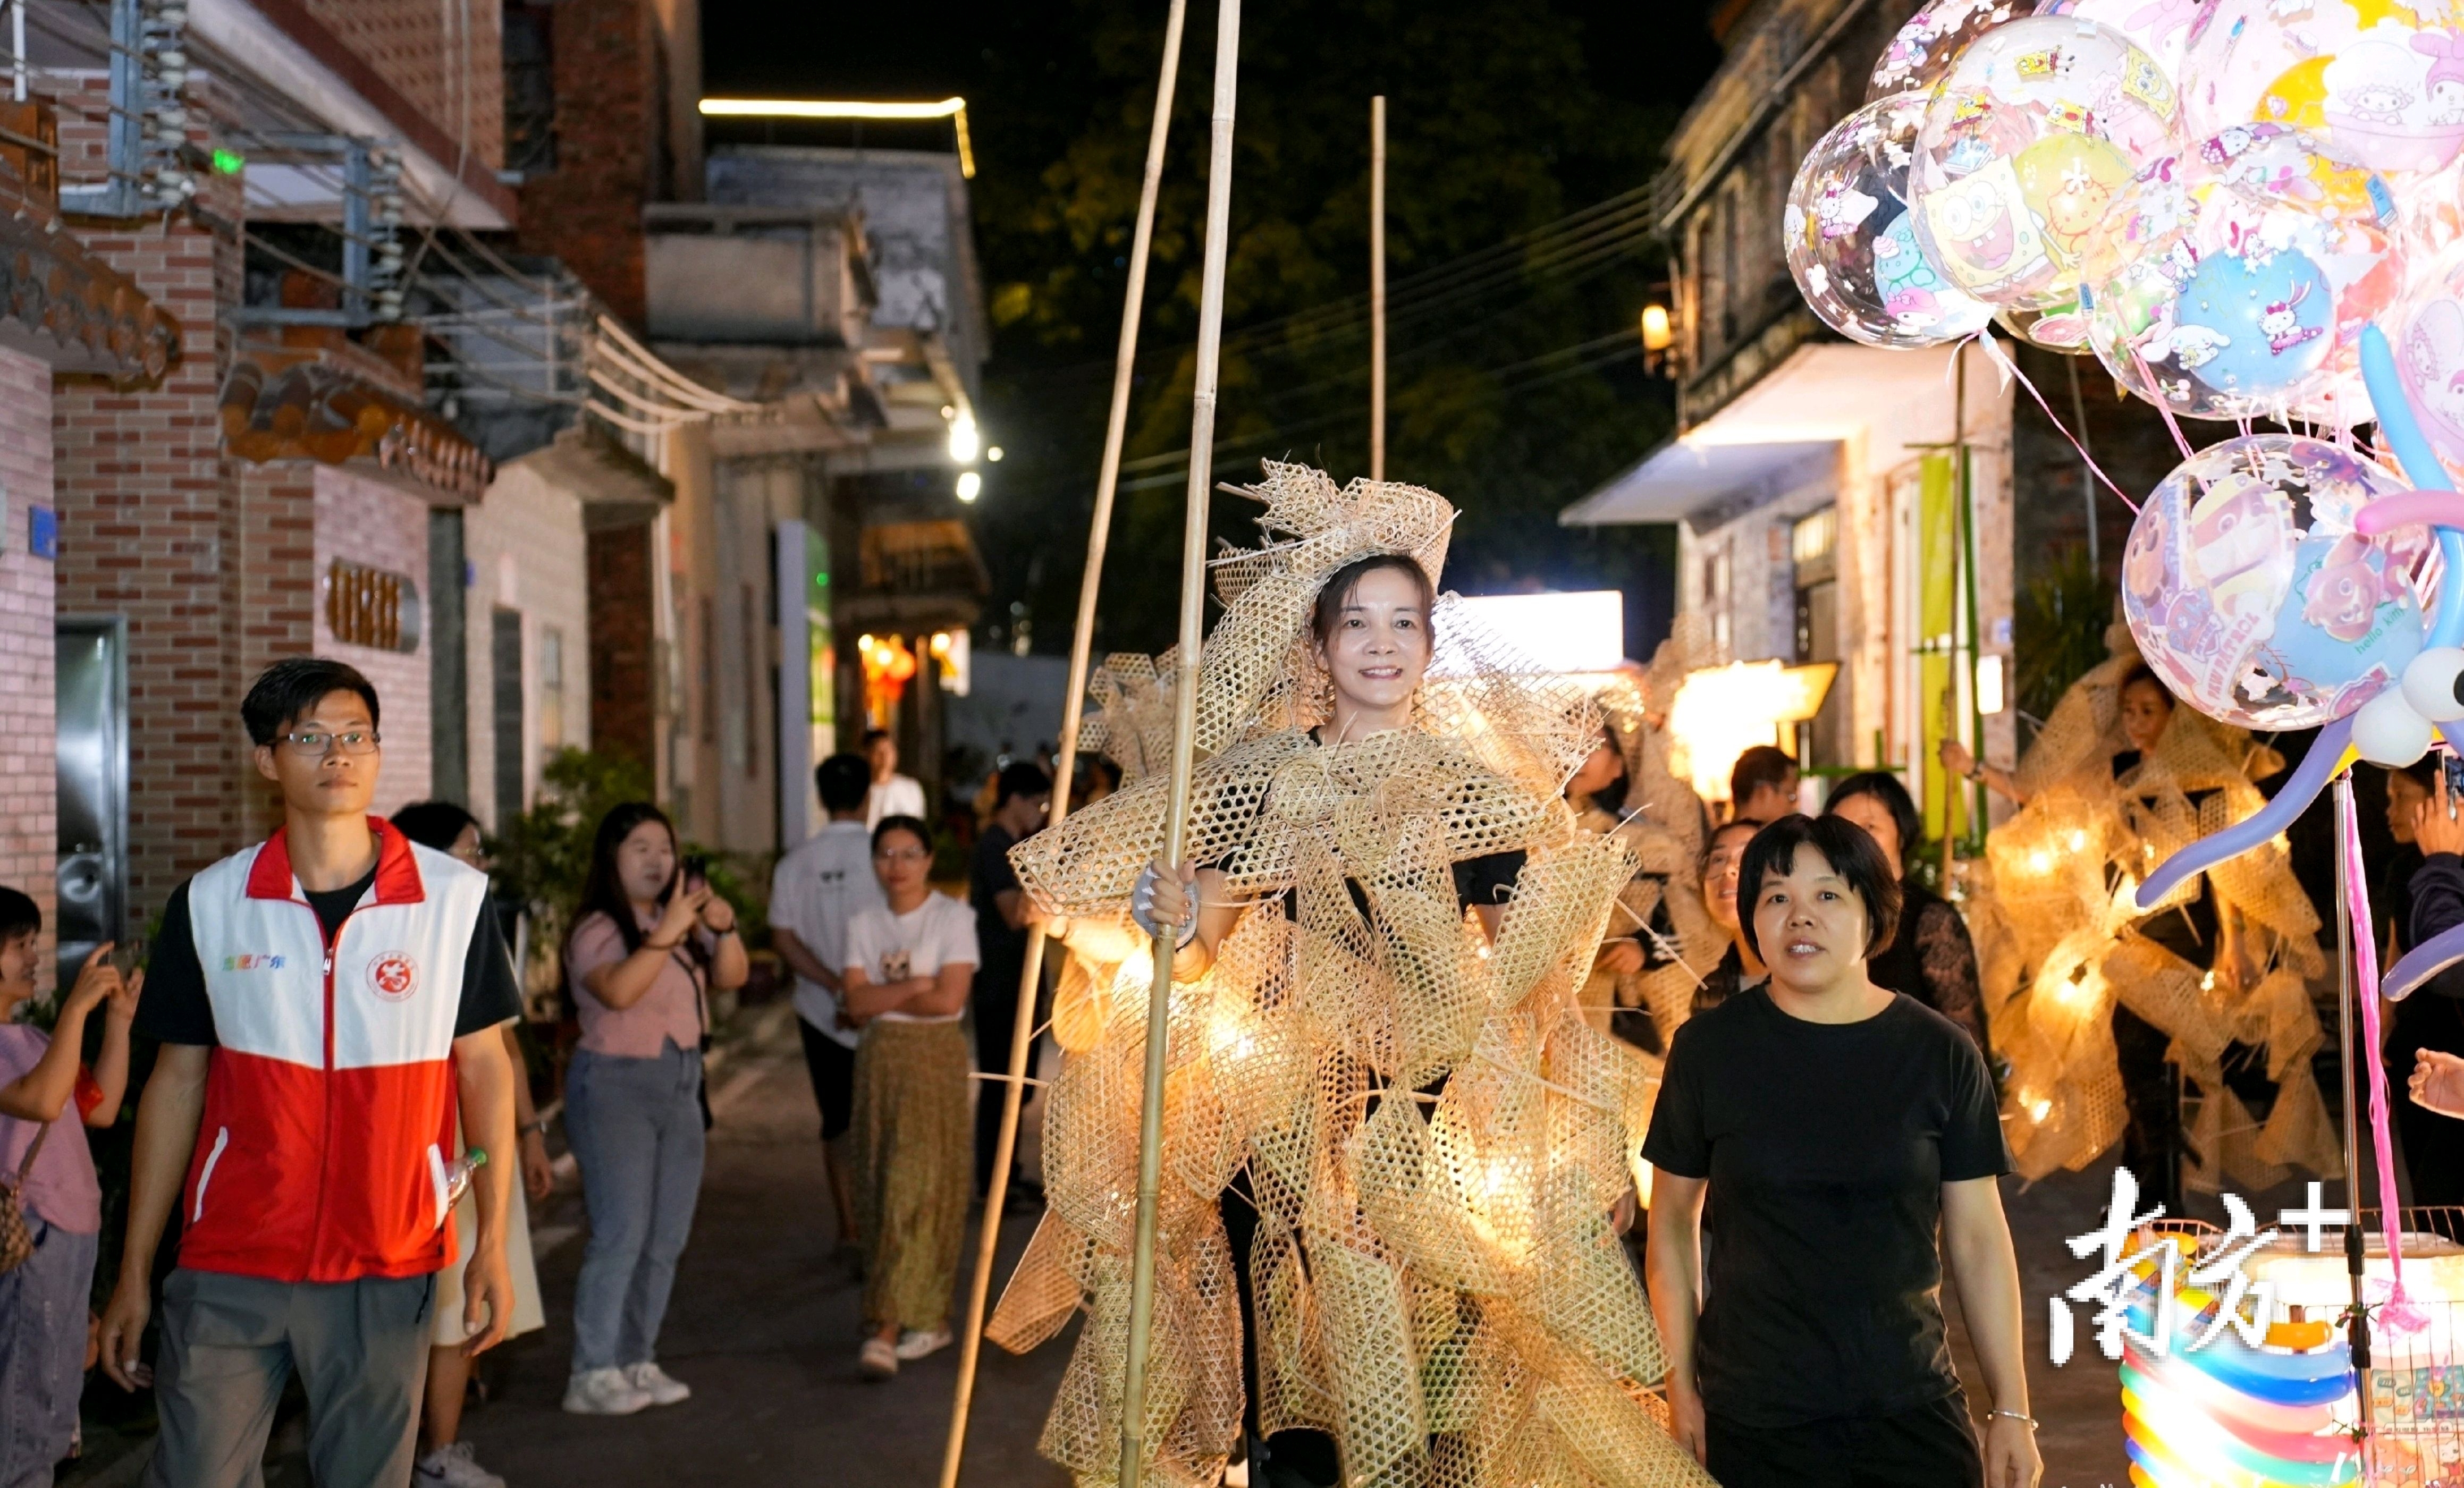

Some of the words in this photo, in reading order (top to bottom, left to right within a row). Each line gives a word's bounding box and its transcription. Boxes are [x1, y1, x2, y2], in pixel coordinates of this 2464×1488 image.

[2214, 612, 2260, 672] PATROL
[2355, 627, 2383, 655] hello
[2207, 669, 2224, 700] PAW
